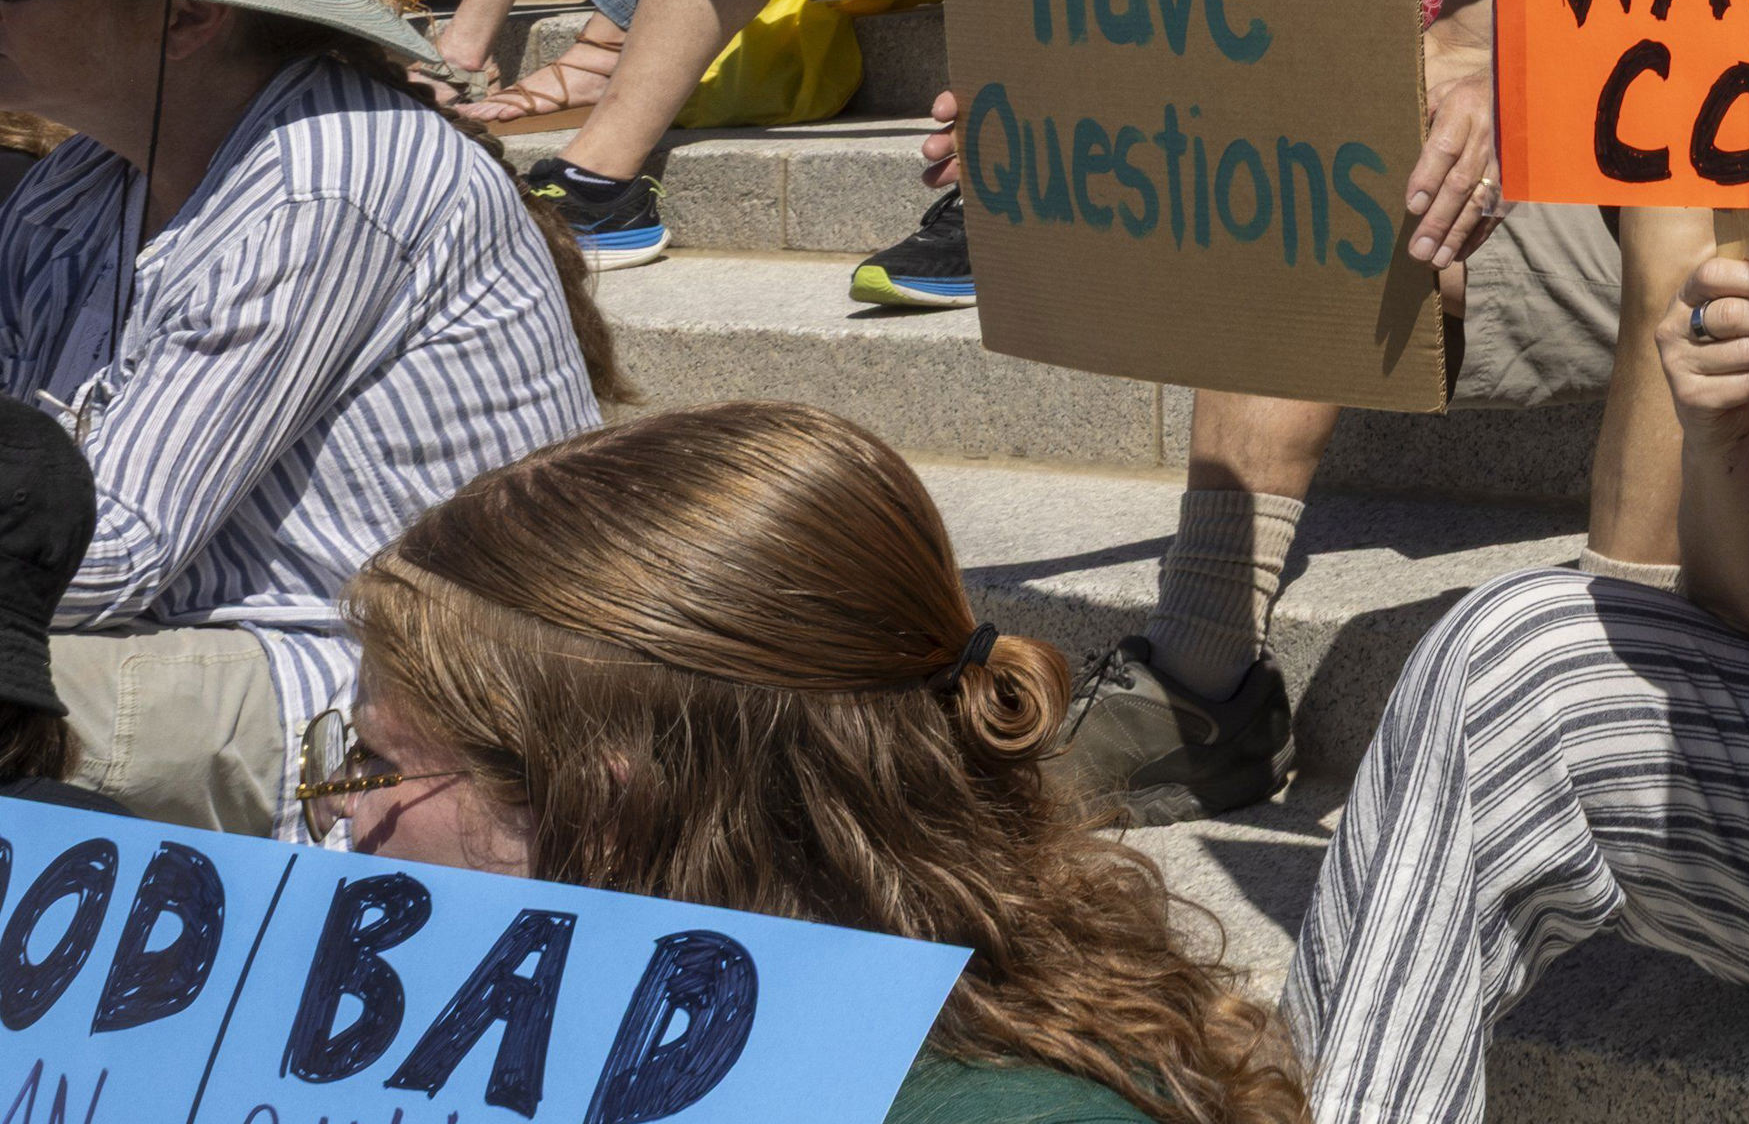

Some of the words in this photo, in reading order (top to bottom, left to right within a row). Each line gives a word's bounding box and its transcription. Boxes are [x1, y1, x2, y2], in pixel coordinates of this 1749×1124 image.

[964, 81, 1394, 278] Questions
[0, 839, 226, 1036] OD
[281, 873, 760, 1124] BAD
